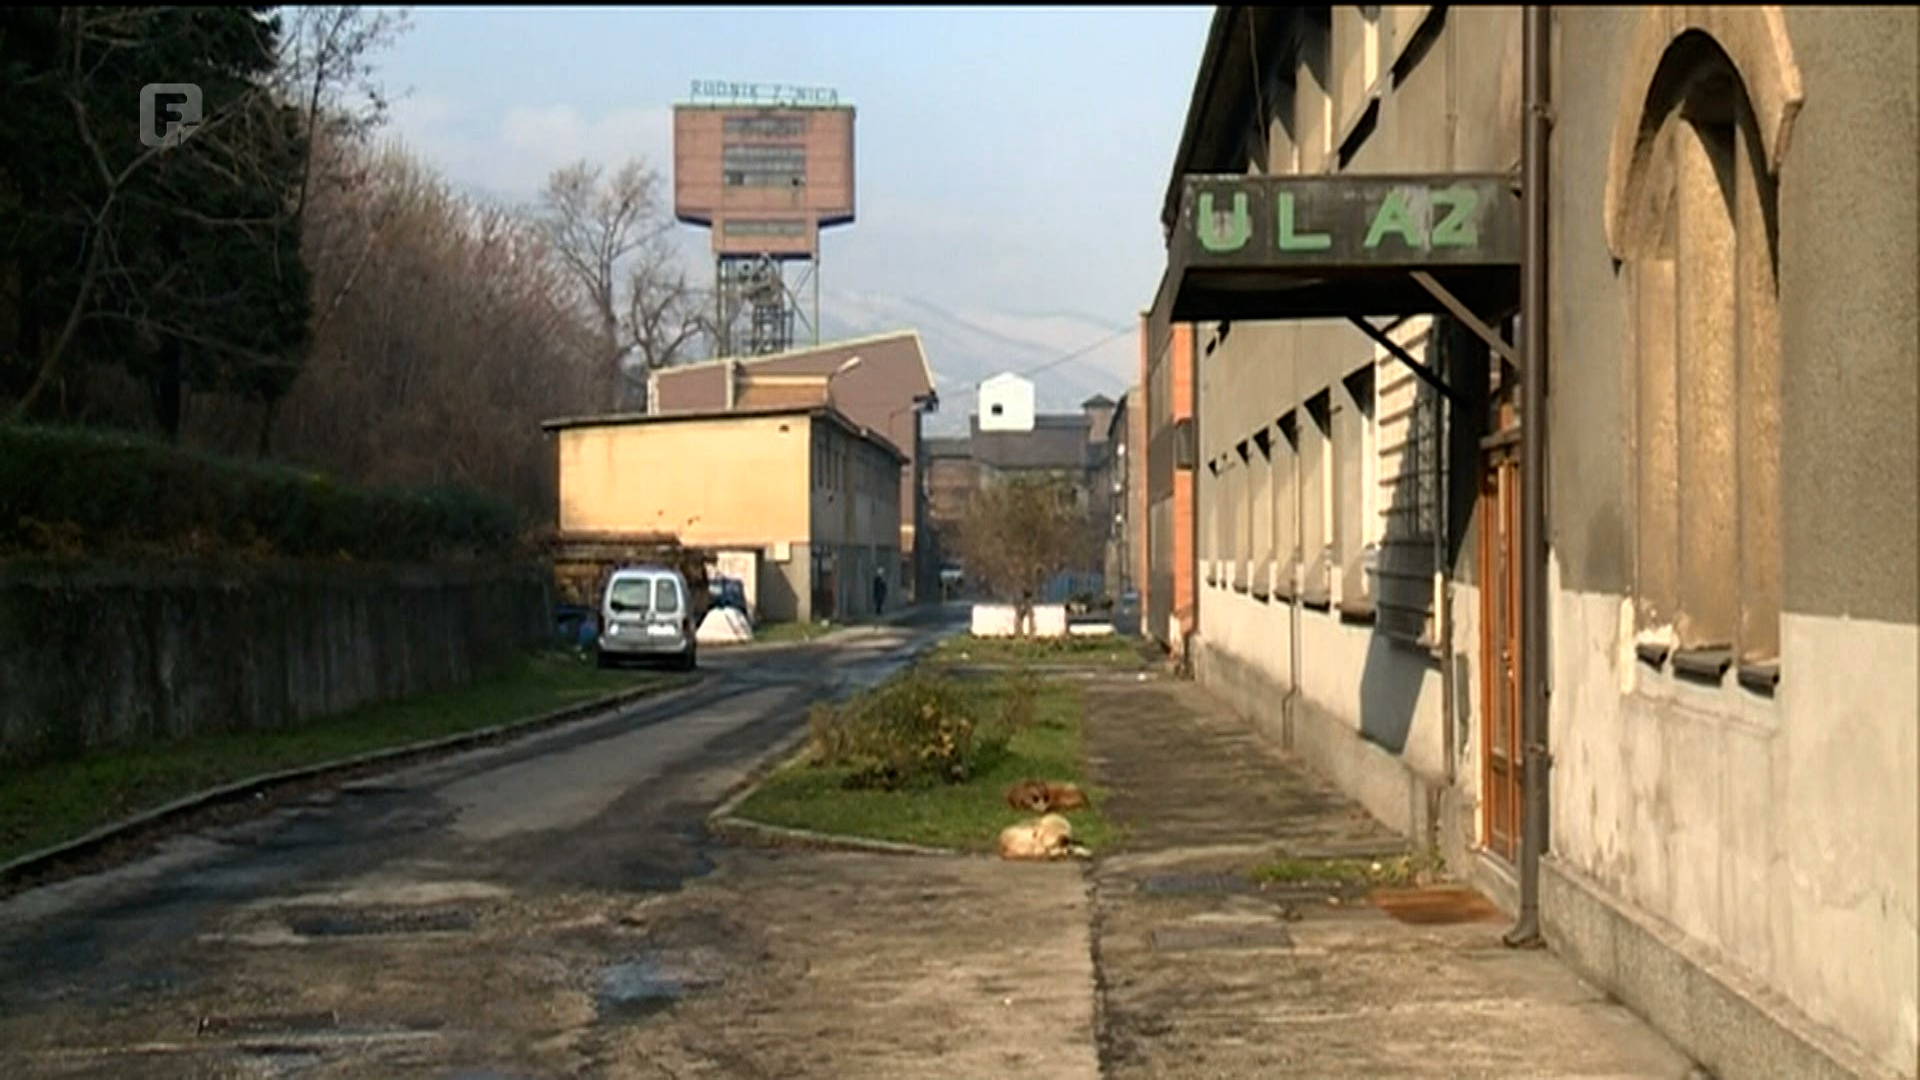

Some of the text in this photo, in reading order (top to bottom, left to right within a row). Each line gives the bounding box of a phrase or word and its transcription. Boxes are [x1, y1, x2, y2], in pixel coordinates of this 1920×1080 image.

[690, 80, 839, 104] RUDNIK ZNICA
[1198, 185, 1479, 252] ULAZ
